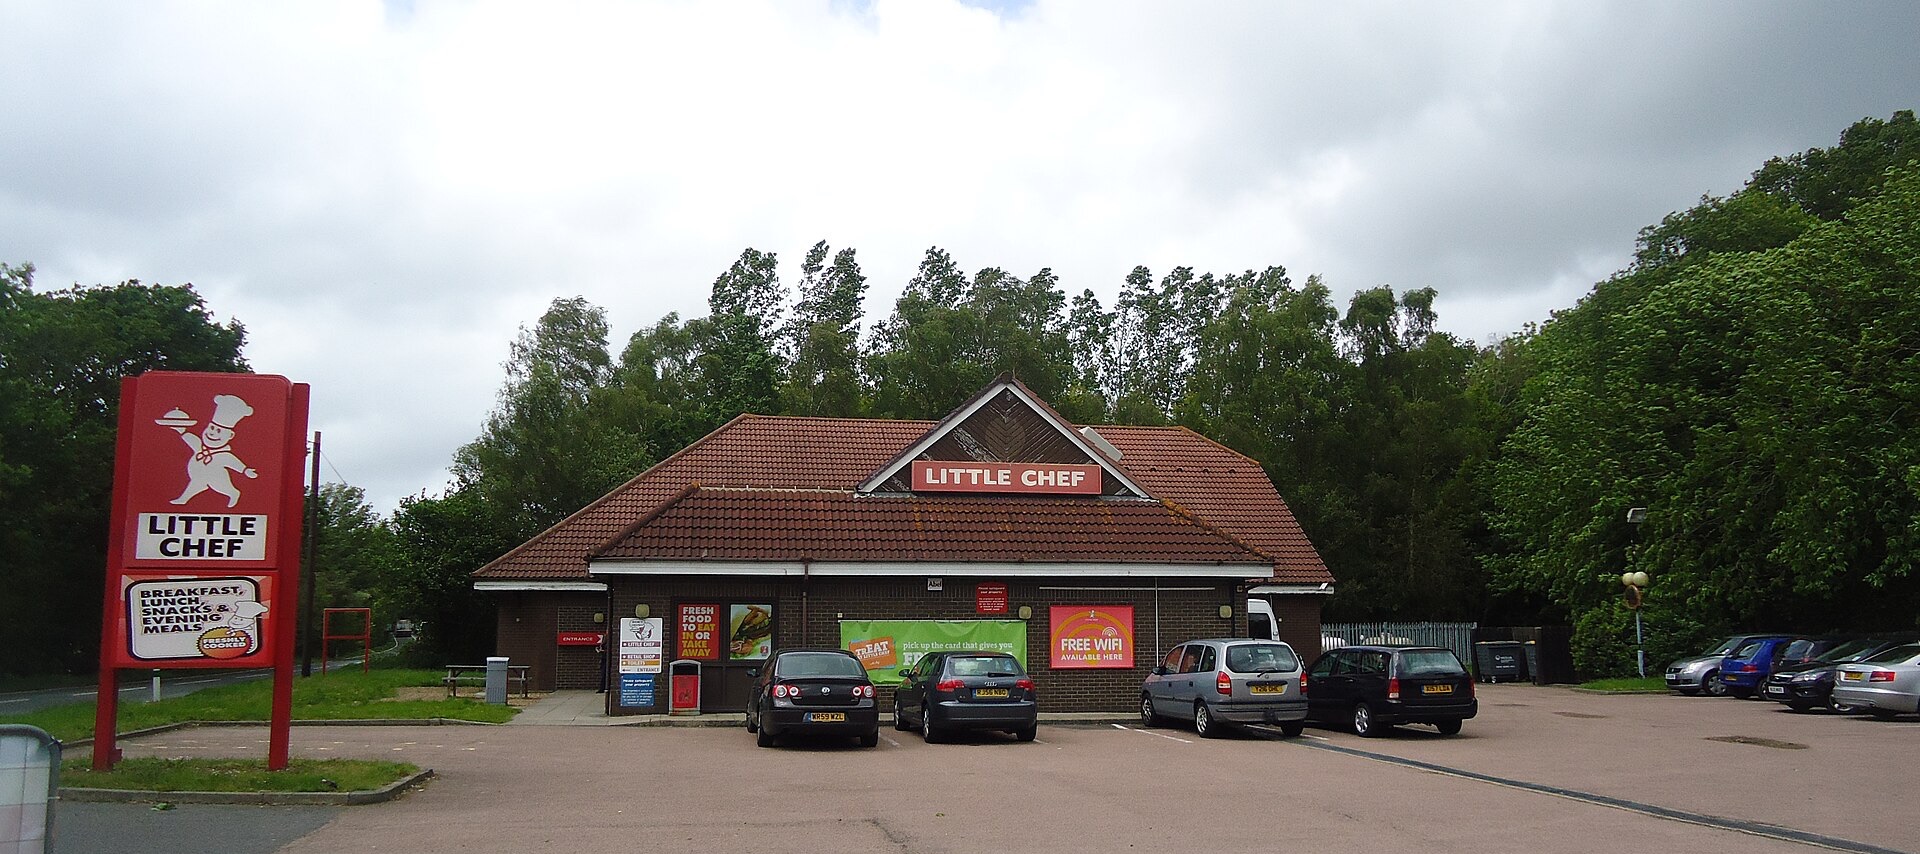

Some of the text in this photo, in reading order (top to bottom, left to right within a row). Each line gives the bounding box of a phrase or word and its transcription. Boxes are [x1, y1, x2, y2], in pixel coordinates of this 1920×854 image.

[925, 468, 1085, 487] LITTLE CHEF
[148, 515, 257, 536] LITTLE
[159, 538, 244, 558] CHEF
[140, 586, 244, 599] BREAKFAST,
[141, 597, 206, 608] LUNCH,
[142, 604, 229, 617] SNACKS &
[682, 606, 715, 615] FRESH
[142, 614, 222, 626] EVENING
[682, 615, 712, 623] FOOD
[143, 624, 203, 635] MEALS
[682, 623, 716, 631] TO EAT
[203, 637, 246, 645] FRESHLY
[682, 632, 711, 640] IN OR
[203, 642, 247, 650] COOKED
[682, 640, 708, 648] TAKE
[855, 640, 889, 656] TREAT
[920, 643, 931, 651] up
[978, 642, 998, 651] gives
[998, 643, 1013, 651] you
[1061, 638, 1123, 651] FREE WIFI
[681, 648, 712, 657] AWAY
[1060, 653, 1101, 661] AVAILABLE
